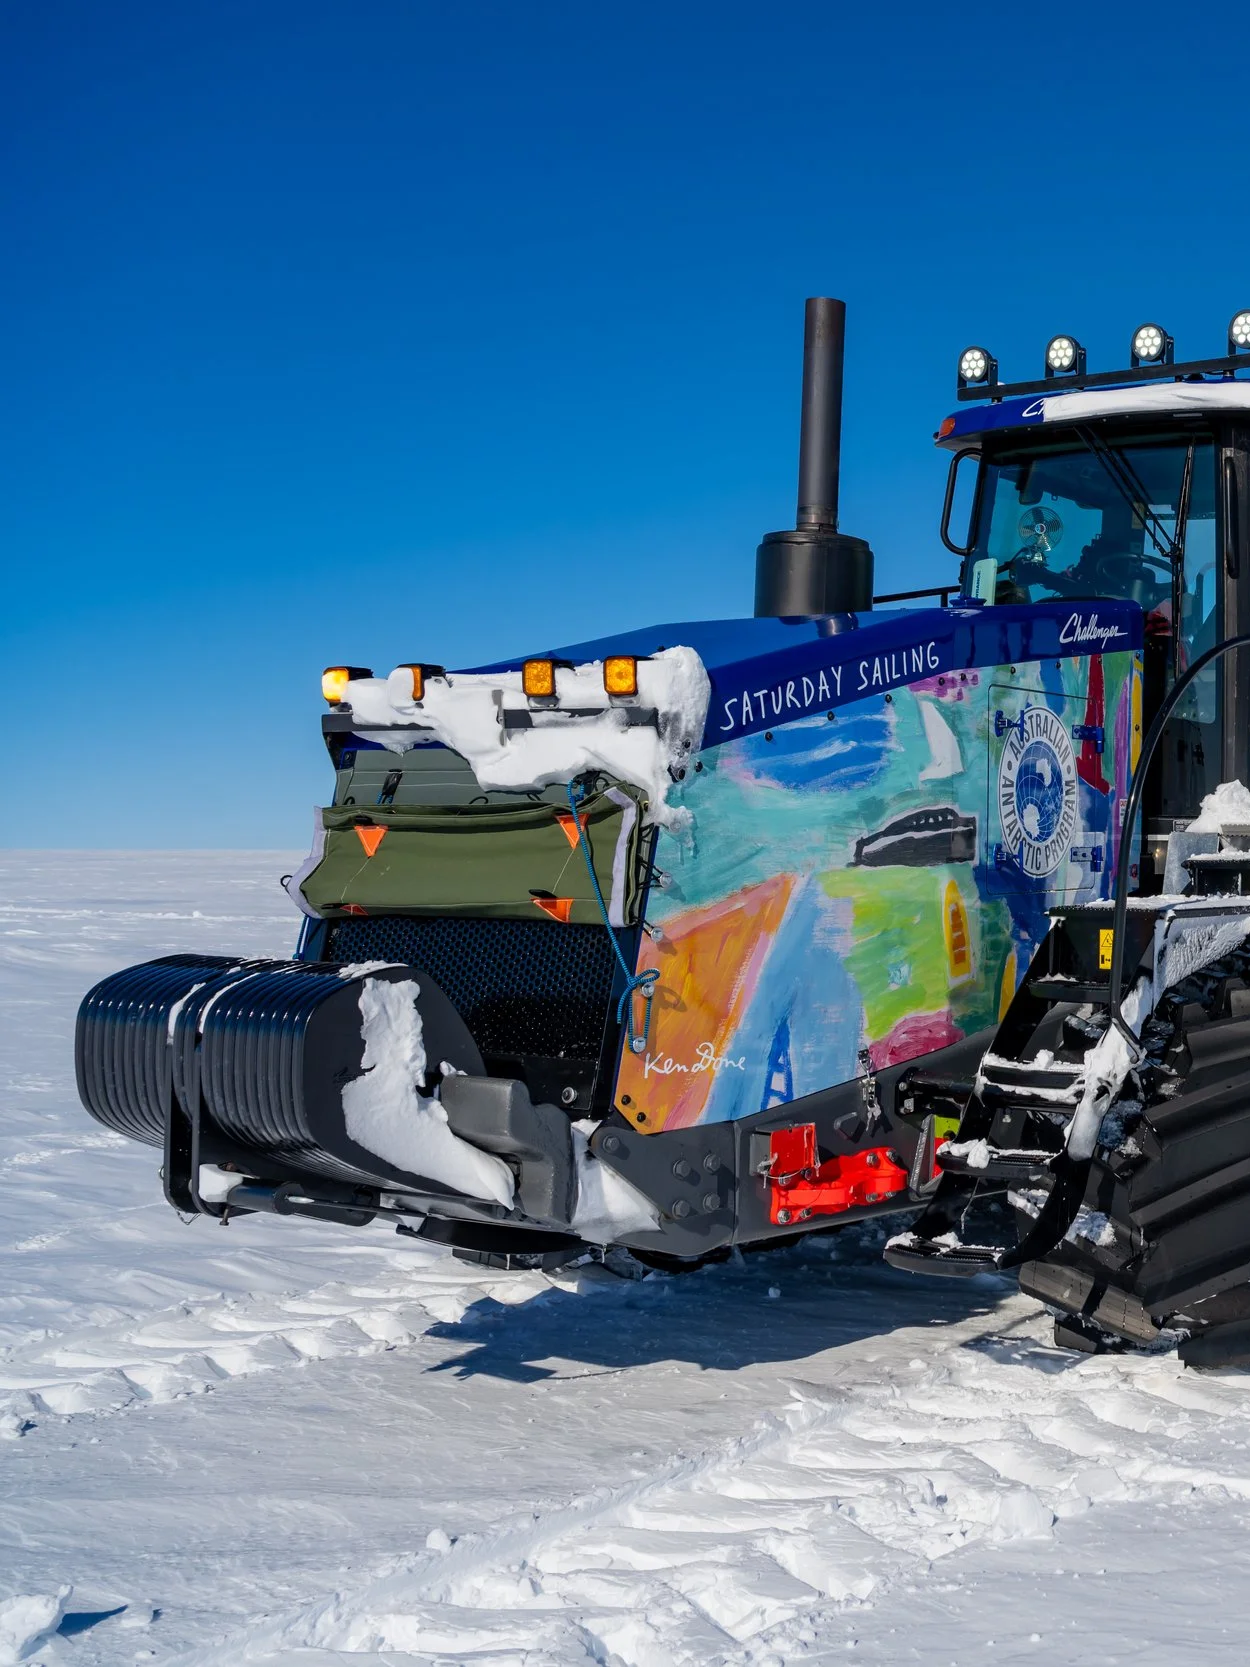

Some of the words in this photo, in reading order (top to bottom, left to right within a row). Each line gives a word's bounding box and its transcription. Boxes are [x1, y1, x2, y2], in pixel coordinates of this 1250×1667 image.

[1059, 612, 1128, 649] Challenger
[719, 665, 842, 731] SATURDAY
[857, 641, 940, 691] SAILING
[1009, 713, 1070, 765] AUSTRALIAN
[1044, 779, 1075, 868] PROGRAM
[644, 1052, 689, 1079] Ken
